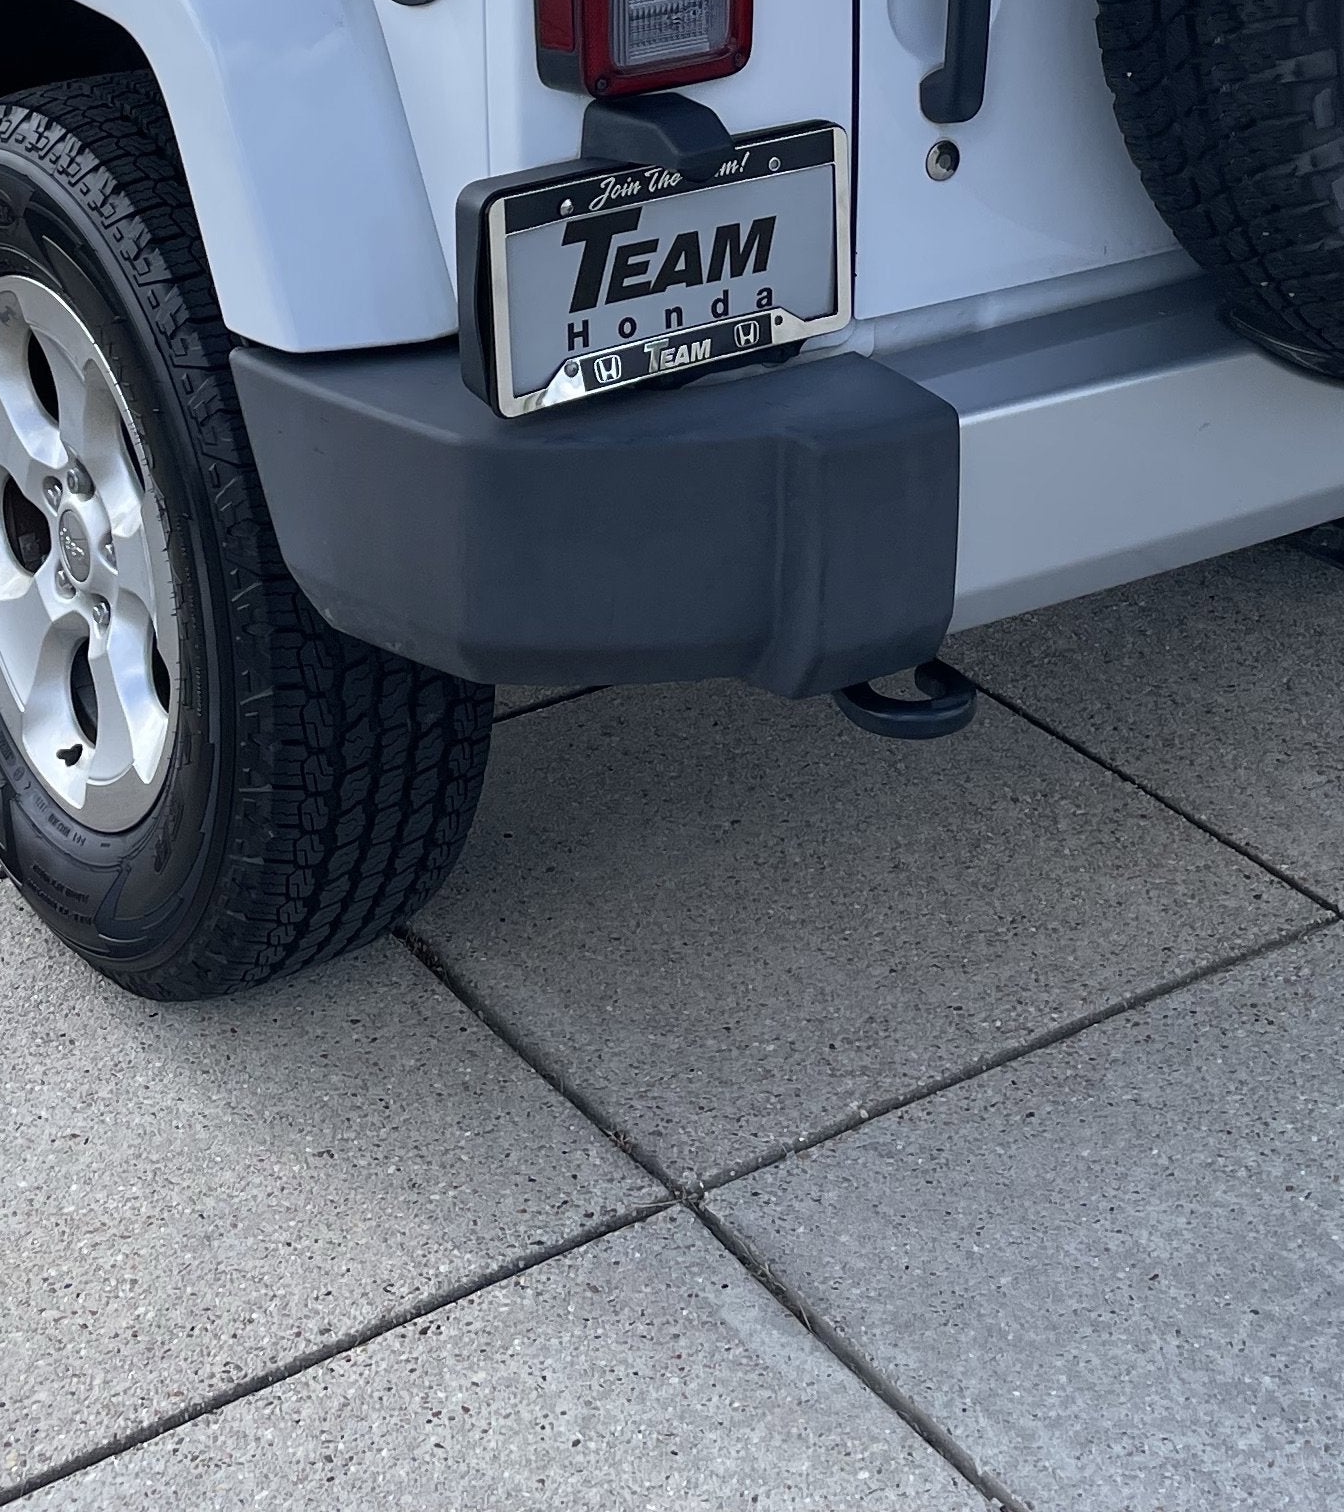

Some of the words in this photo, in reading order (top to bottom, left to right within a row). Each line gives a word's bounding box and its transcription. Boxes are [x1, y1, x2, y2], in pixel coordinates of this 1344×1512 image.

[588, 176, 642, 211] Join
[644, 167, 684, 193] The
[567, 287, 773, 351] Honda
[643, 337, 712, 373] TEAM
